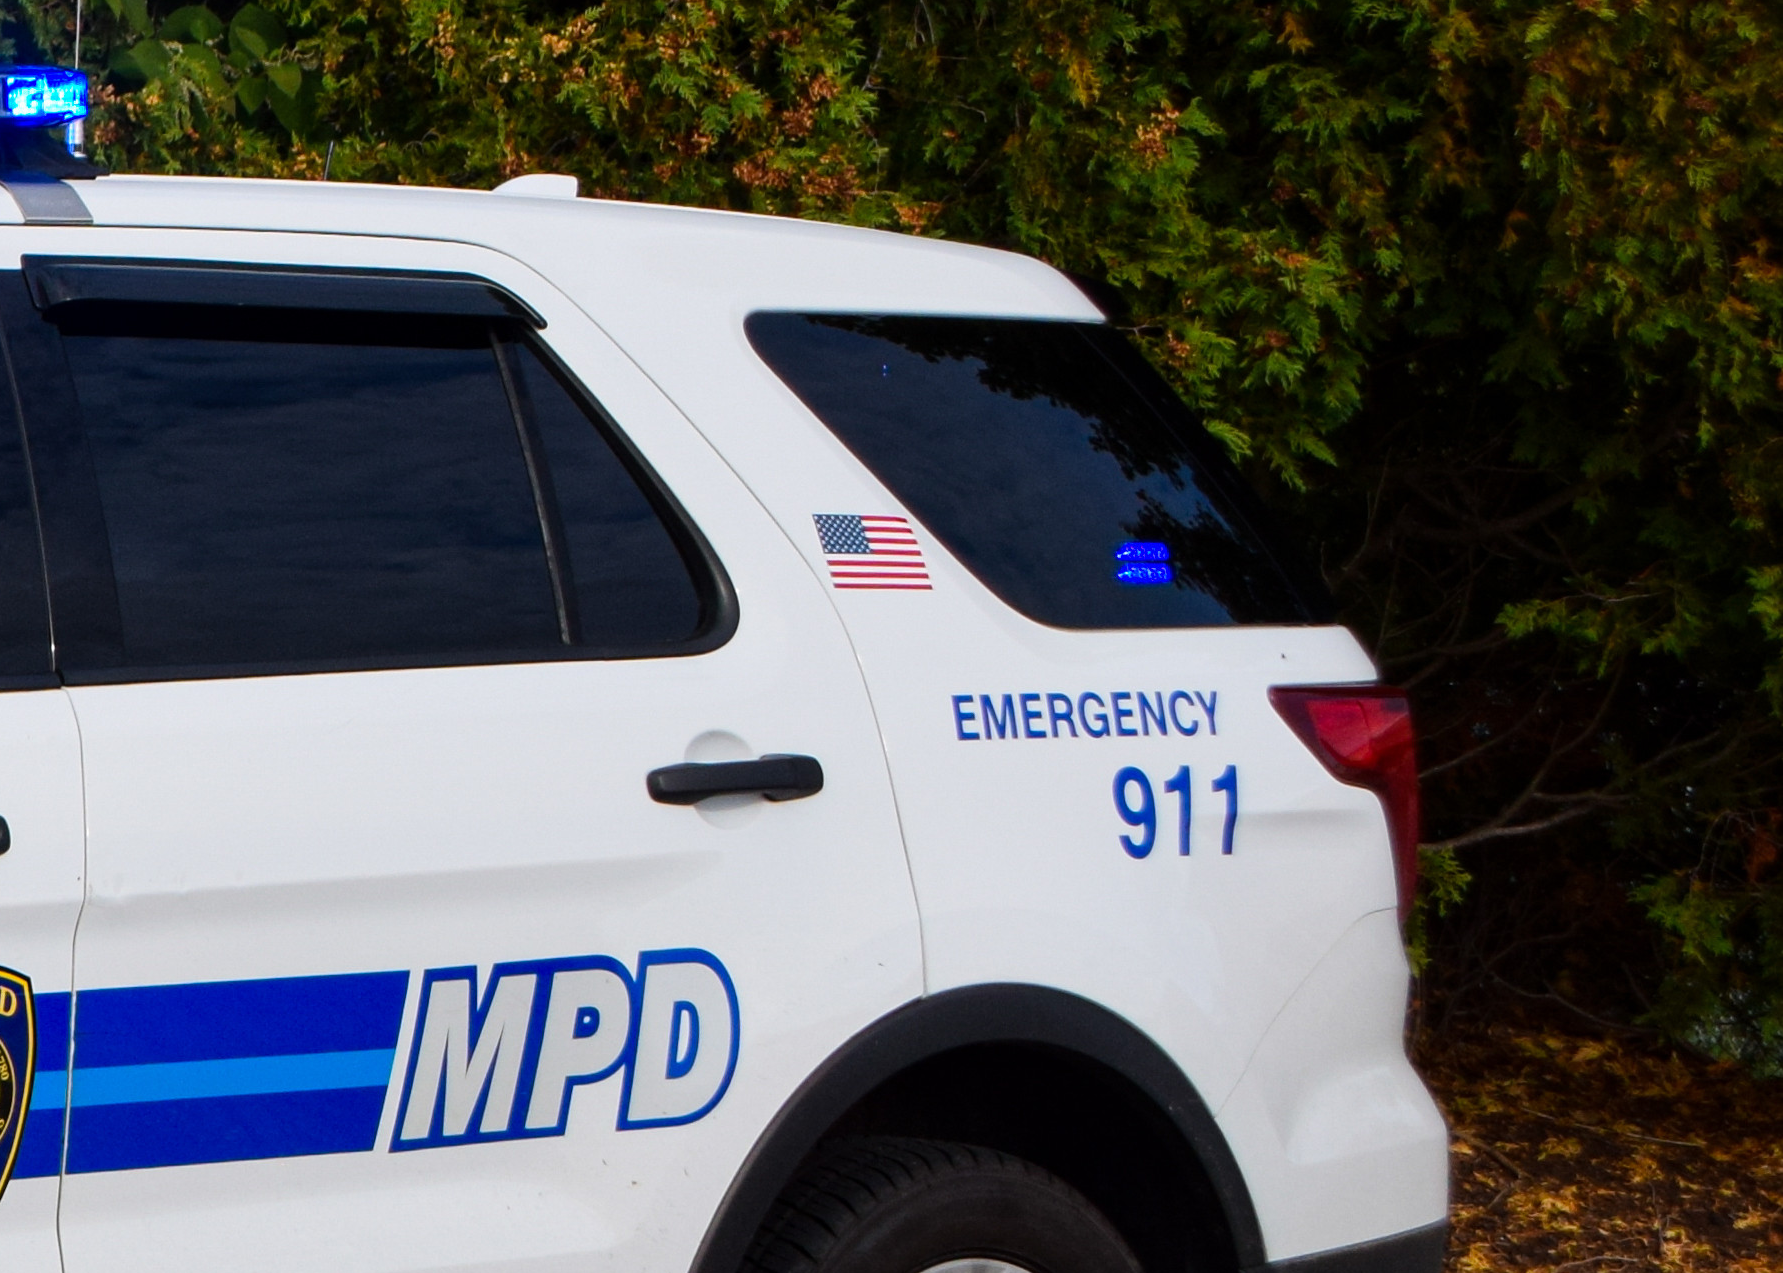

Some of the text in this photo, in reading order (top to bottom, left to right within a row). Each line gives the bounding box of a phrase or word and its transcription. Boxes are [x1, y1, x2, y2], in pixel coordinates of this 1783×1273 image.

[952, 689, 1219, 741] EMERGENCY
[1113, 763, 1240, 860] 911
[388, 946, 742, 1153] MPD
